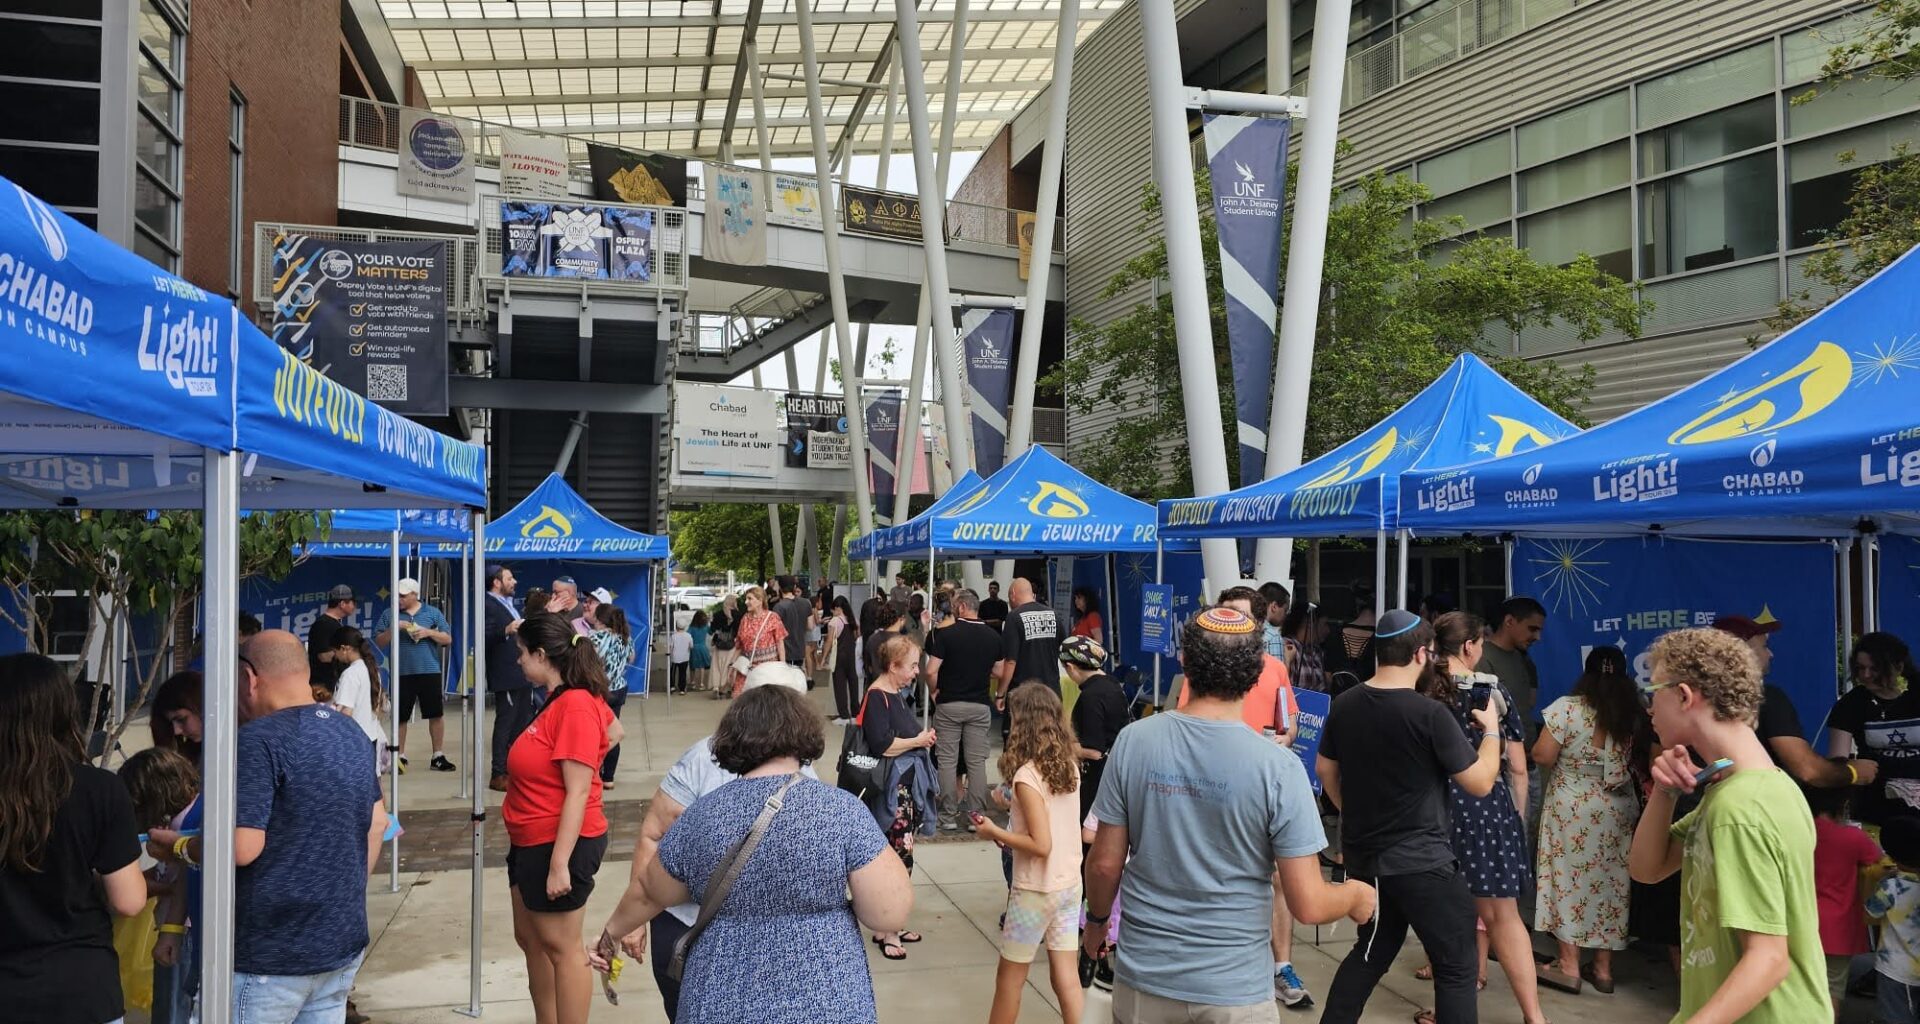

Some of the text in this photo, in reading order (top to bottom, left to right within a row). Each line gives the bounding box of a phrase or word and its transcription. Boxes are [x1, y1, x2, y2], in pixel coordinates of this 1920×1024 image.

[517, 163, 542, 173] LOVE
[544, 168, 560, 177] YOU
[424, 182, 450, 191] adores
[1233, 182, 1265, 197] UNF
[1220, 198, 1238, 207] John
[1250, 199, 1278, 210] Delaney
[1223, 207, 1277, 217] Student Union
[615, 237, 646, 247] OSPREY
[615, 245, 646, 257] PLAZA
[354, 253, 435, 268] YOUR VOTE
[555, 258, 599, 267] COMMUNITY
[357, 267, 429, 280] MATTERS
[580, 266, 599, 274] FIRST
[152, 275, 170, 293] LET
[336, 281, 365, 291] Osprey
[367, 283, 386, 291] Vote
[418, 285, 442, 293] digital
[0, 252, 94, 336] CHABAD
[348, 290, 364, 298] tool
[384, 291, 405, 300] helps
[367, 304, 383, 312] Get
[384, 305, 408, 314] ready
[404, 311, 434, 319] friends
[367, 324, 430, 333] Get automated
[367, 330, 408, 339] reminders
[25, 318, 87, 357] CAMPUS
[138, 302, 218, 389] Light!
[367, 344, 416, 353] Win real-life
[367, 351, 400, 359] rewards
[980, 348, 1001, 358] UNF
[274, 347, 365, 445] JOYFULLY
[709, 402, 747, 414] Chabad
[787, 397, 846, 415] HEAR THAT
[377, 408, 436, 469] JEWISHLY
[701, 429, 758, 439] The Heart of
[1871, 433, 1896, 446] LET
[686, 438, 719, 447] Jewish
[753, 441, 773, 449] UNF
[811, 444, 835, 452] STUDENT
[440, 434, 480, 482] PROUDLY
[822, 453, 834, 461] CAN
[1601, 462, 1619, 470] LET
[1619, 454, 1657, 467] HERE
[1434, 470, 1459, 483] HERE
[1593, 458, 1679, 503] Light!
[1722, 470, 1804, 489] CHABAD
[1417, 476, 1476, 512] Light!
[1504, 488, 1559, 503] CHABAD
[1749, 486, 1801, 496] CAMPUS
[1289, 483, 1361, 520] PROUDLY
[1522, 501, 1556, 509] CAMPUS
[1168, 500, 1218, 527] JOYFULLY
[1219, 493, 1286, 524] JEWISHLY
[953, 521, 1032, 542] JOYFULLY
[1041, 523, 1123, 542] JEWISHLY
[514, 537, 584, 552] JEWISHLY
[592, 537, 655, 552] PROUDLY
[265, 597, 290, 607] LET
[1024, 620, 1057, 629] REBUILD
[1593, 609, 1717, 632] LET HERE BE
[1295, 710, 1325, 728] TECTION
[1297, 725, 1319, 741] PRIDE
[1146, 781, 1202, 799] magnetic
[1217, 782, 1228, 791] of
